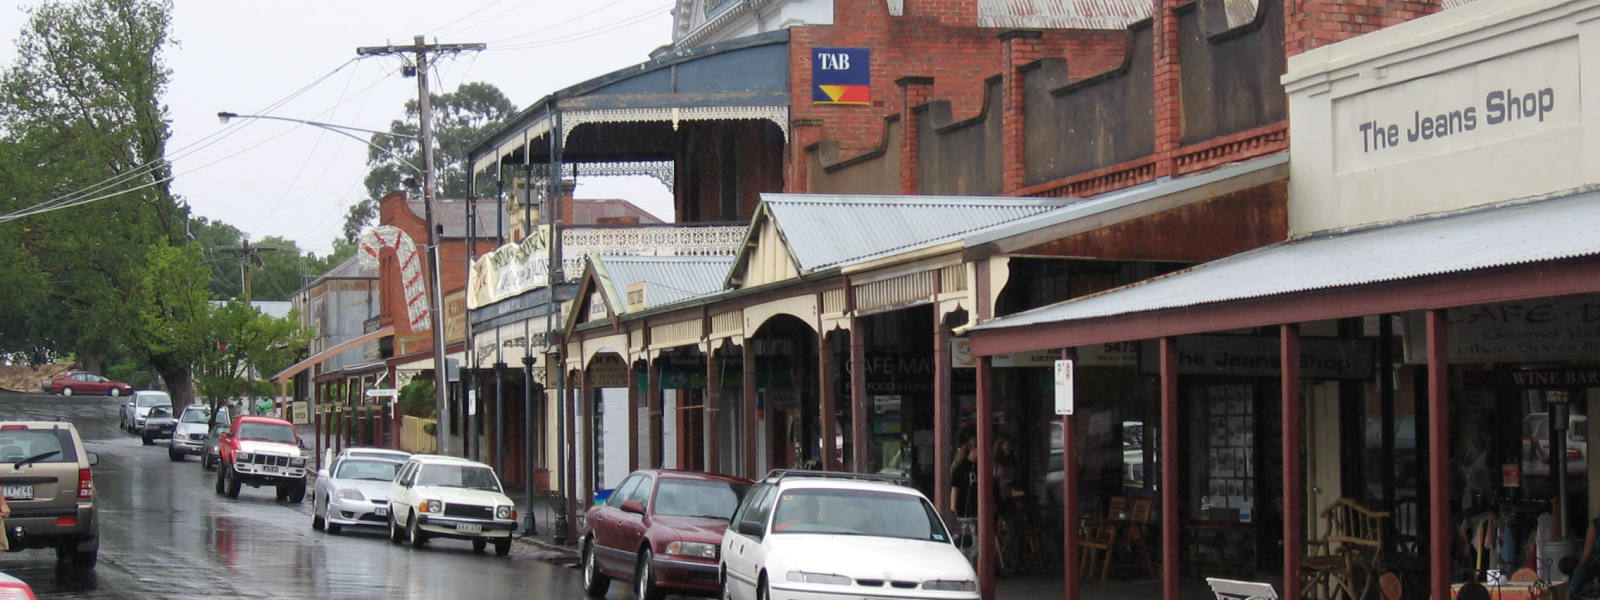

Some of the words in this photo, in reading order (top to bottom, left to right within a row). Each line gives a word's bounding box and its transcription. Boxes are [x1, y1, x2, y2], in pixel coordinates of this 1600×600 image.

[818, 53, 850, 70] TAB
[1359, 120, 1399, 153] The
[1407, 105, 1477, 143] Jeans
[1486, 87, 1554, 125] Shop
[1179, 351, 1206, 367] he
[1513, 369, 1561, 386] WINE
